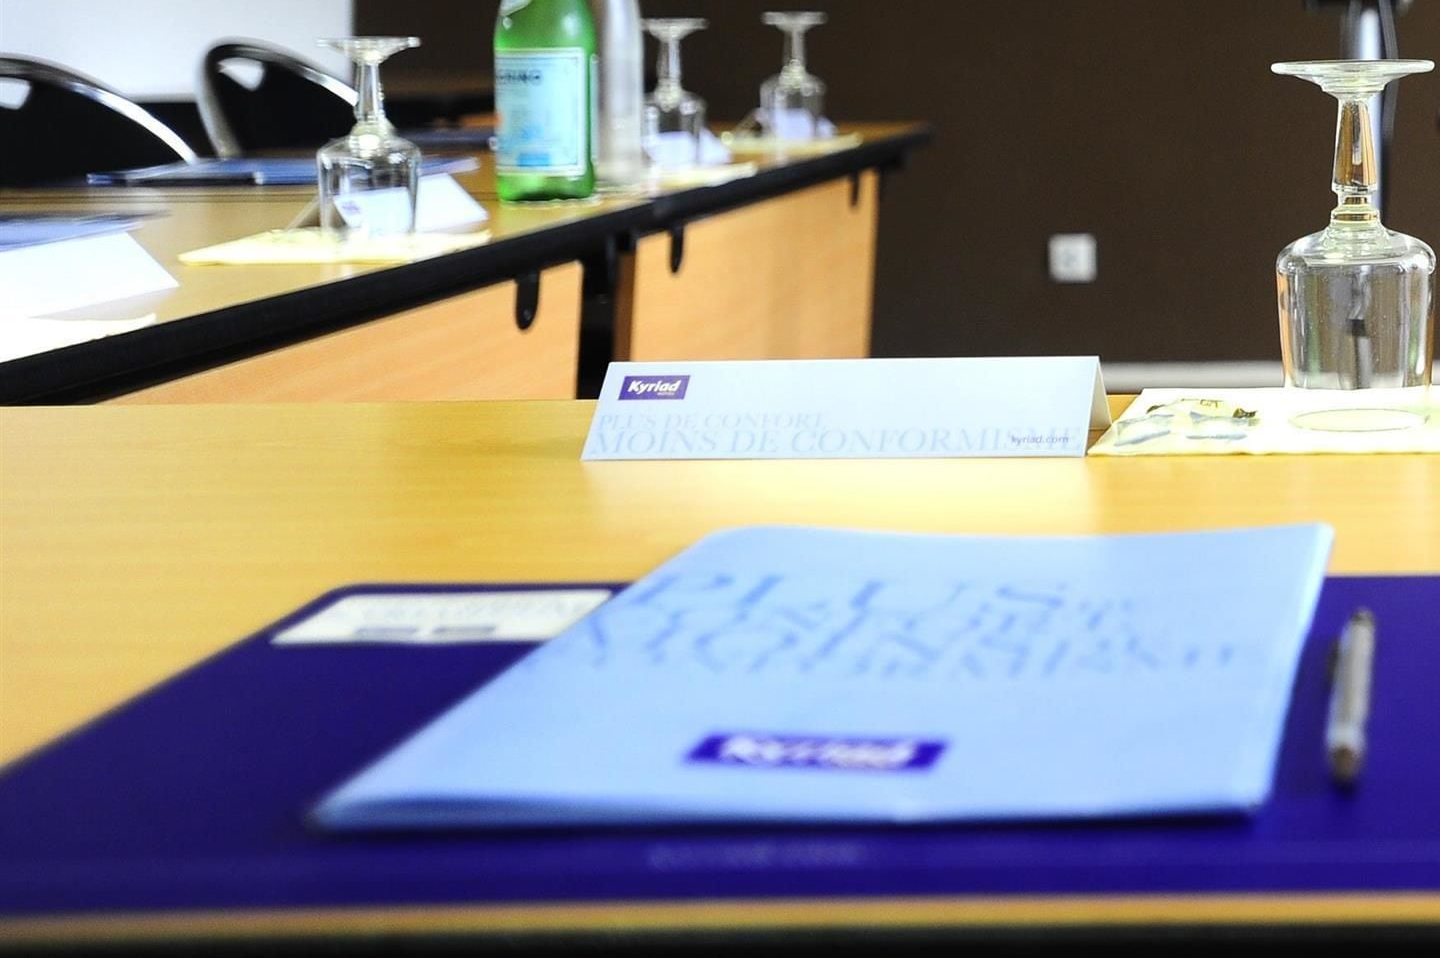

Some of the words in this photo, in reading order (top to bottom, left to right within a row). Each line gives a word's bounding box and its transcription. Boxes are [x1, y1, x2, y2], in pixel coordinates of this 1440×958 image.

[627, 380, 682, 395] Kyriad
[590, 429, 717, 454] MOINS
[730, 429, 779, 454] DE
[1011, 434, 1070, 446] kyriad.com
